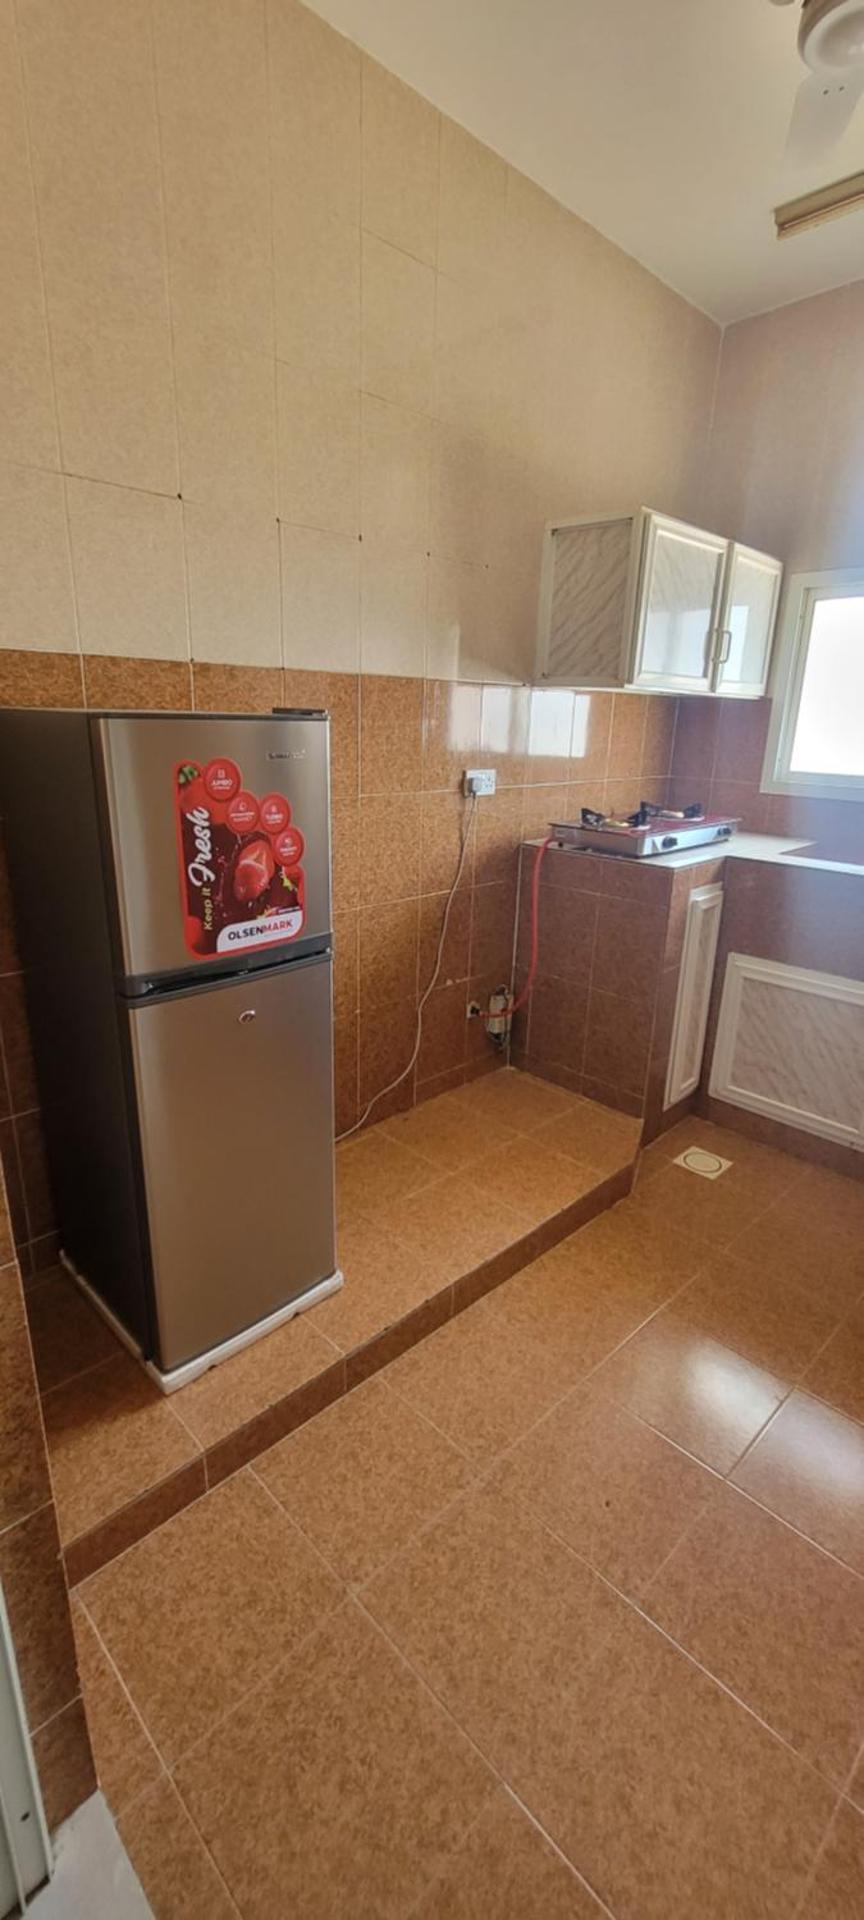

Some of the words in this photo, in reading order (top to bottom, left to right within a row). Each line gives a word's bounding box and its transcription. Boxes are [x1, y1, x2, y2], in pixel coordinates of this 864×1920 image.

[187, 807, 215, 886] Fresh
[203, 898, 213, 931] Keep
[228, 920, 292, 940] OLSENMARK
